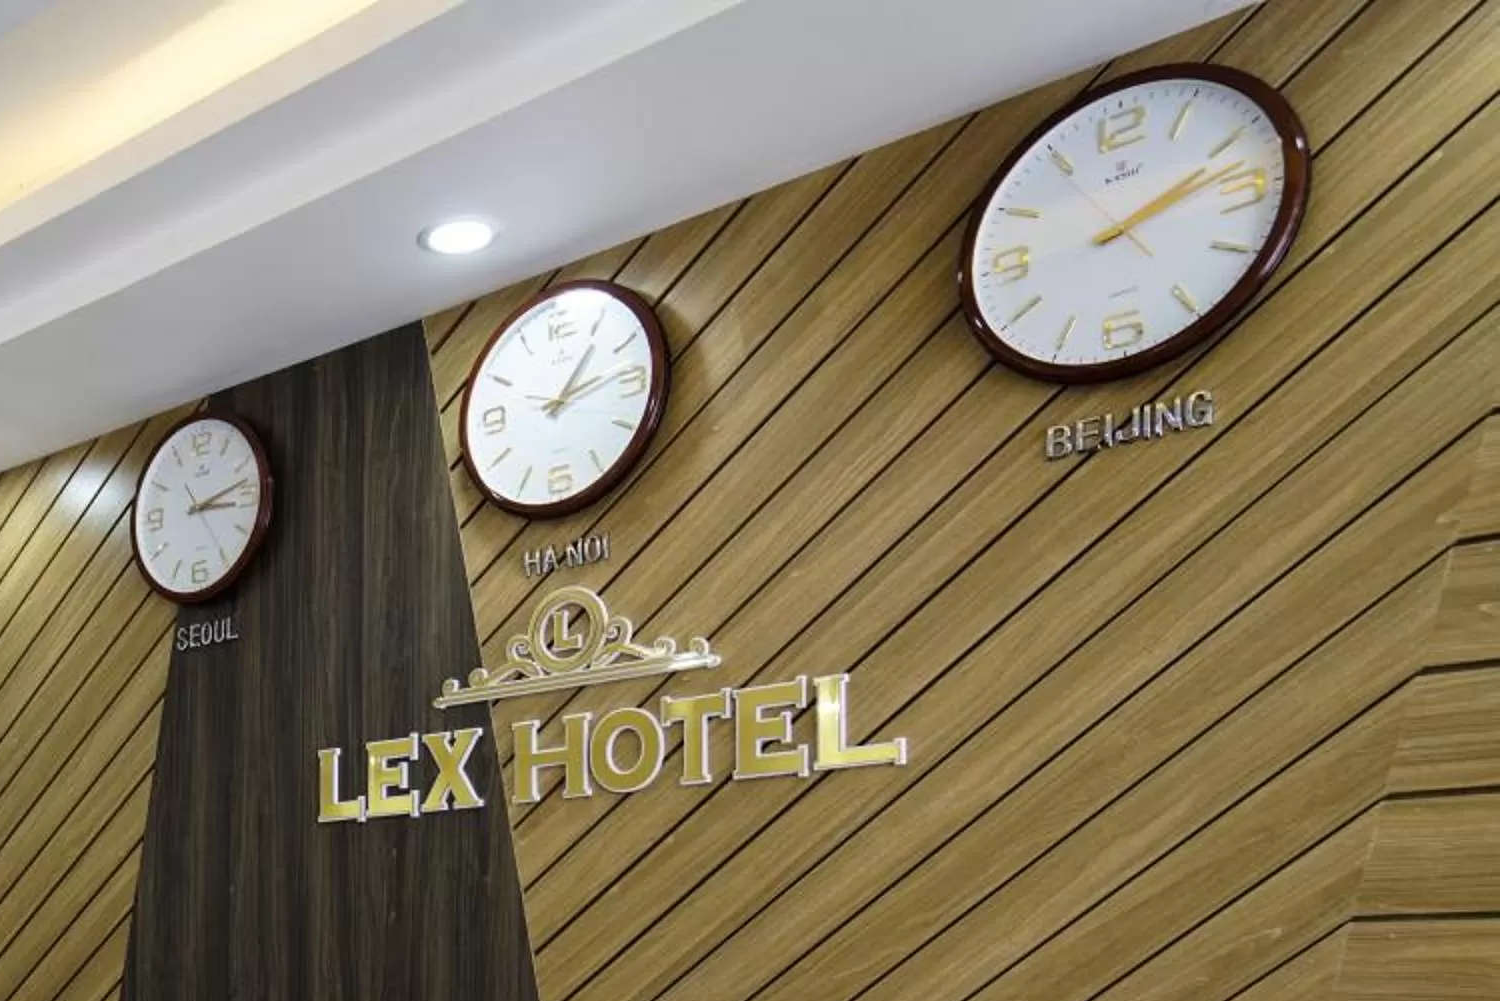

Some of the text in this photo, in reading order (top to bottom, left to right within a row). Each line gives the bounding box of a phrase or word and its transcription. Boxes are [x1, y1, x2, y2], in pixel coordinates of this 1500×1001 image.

[1097, 105, 1148, 154] 12
[1219, 168, 1267, 216] 3
[993, 245, 1030, 285] 9
[1103, 310, 1145, 351] 6
[617, 365, 646, 399] 3
[483, 405, 506, 436] 9
[1044, 390, 1215, 460] BEIJING
[147, 508, 164, 531] 9
[191, 559, 208, 584] 6
[176, 616, 239, 651] SEOUL
[552, 610, 583, 653] L
[317, 673, 908, 823] LEX HOTEL
